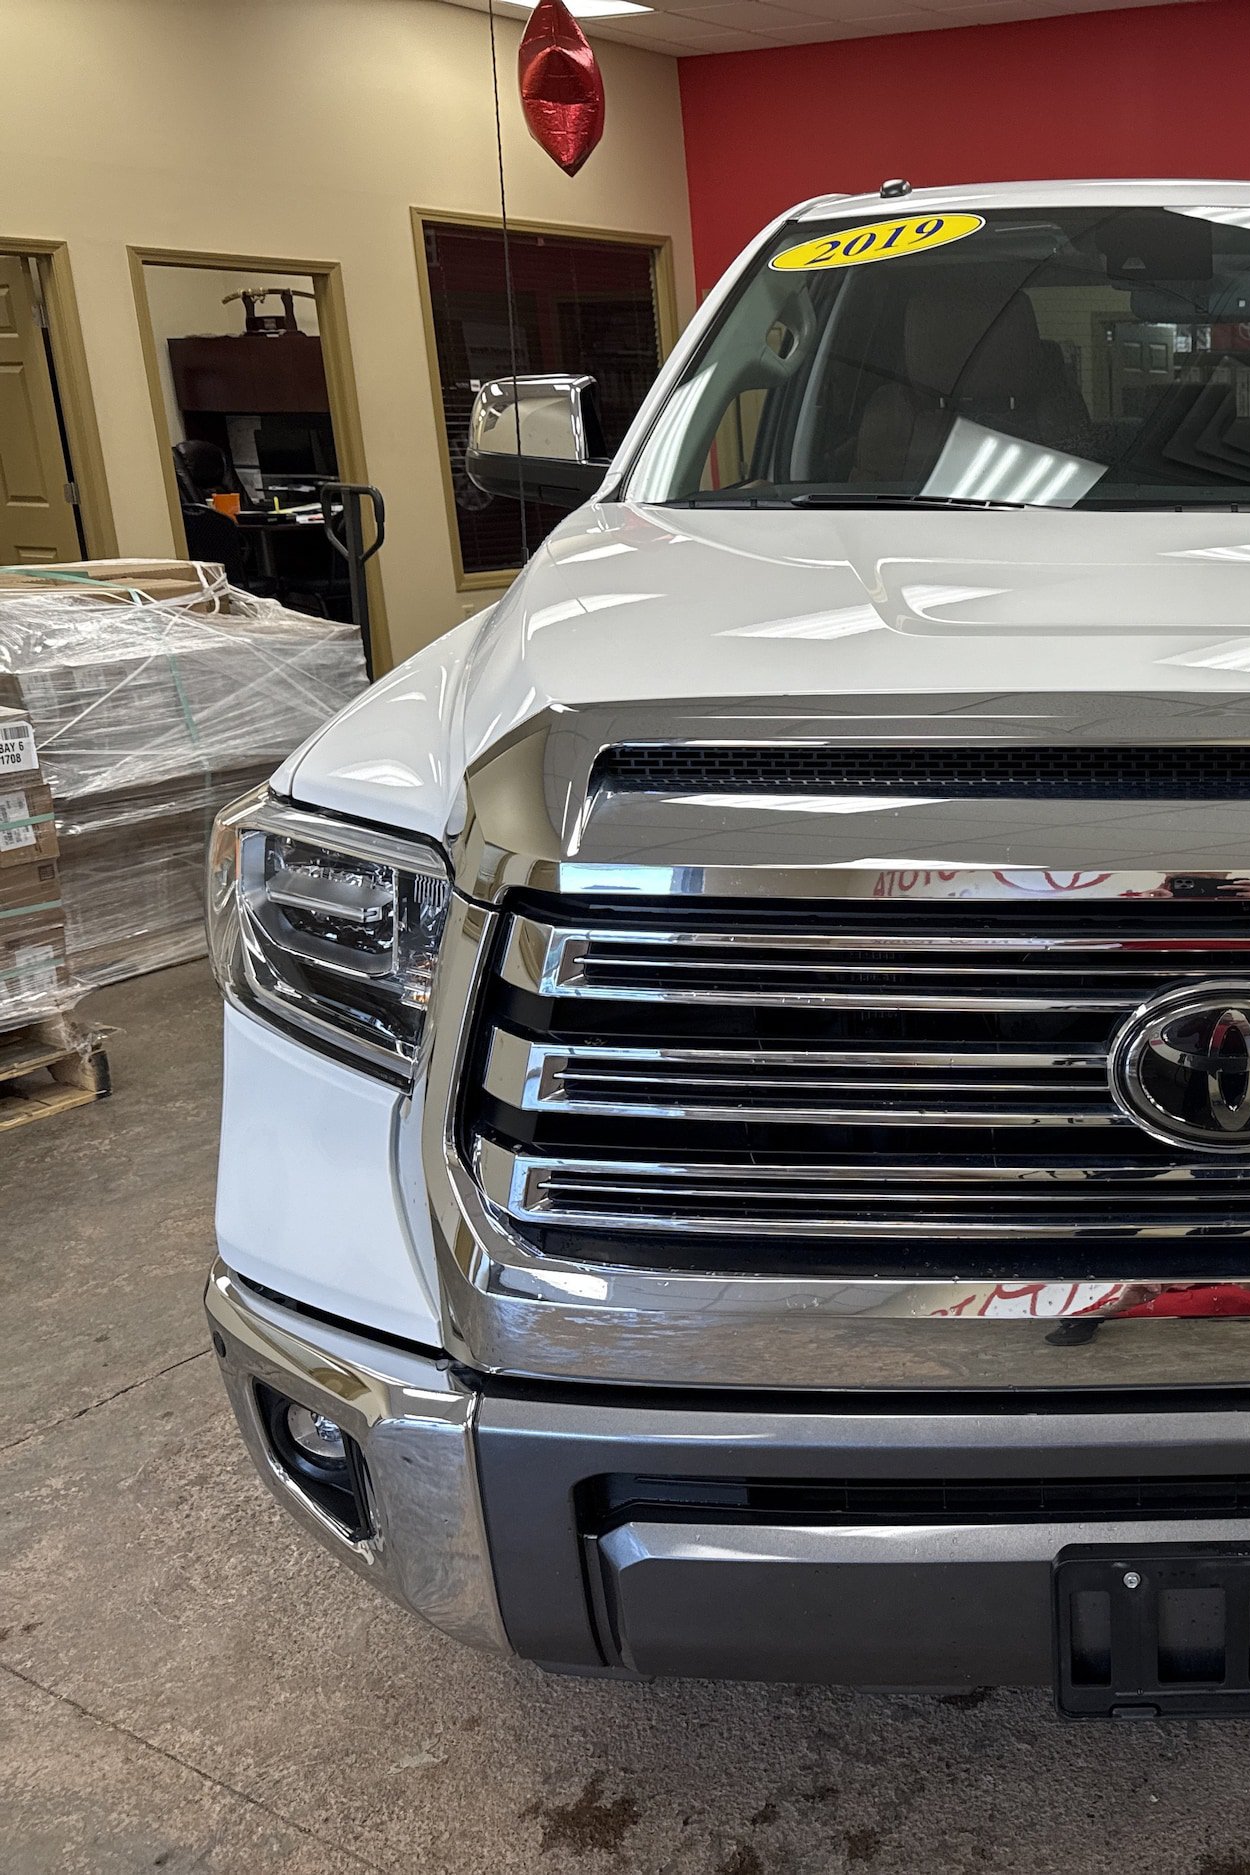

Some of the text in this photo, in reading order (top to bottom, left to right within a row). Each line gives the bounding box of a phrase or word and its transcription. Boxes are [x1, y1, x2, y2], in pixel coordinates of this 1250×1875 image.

[804, 219, 944, 265] 2019
[19, 741, 24, 751] 6
[0, 753, 21, 765] 1708
